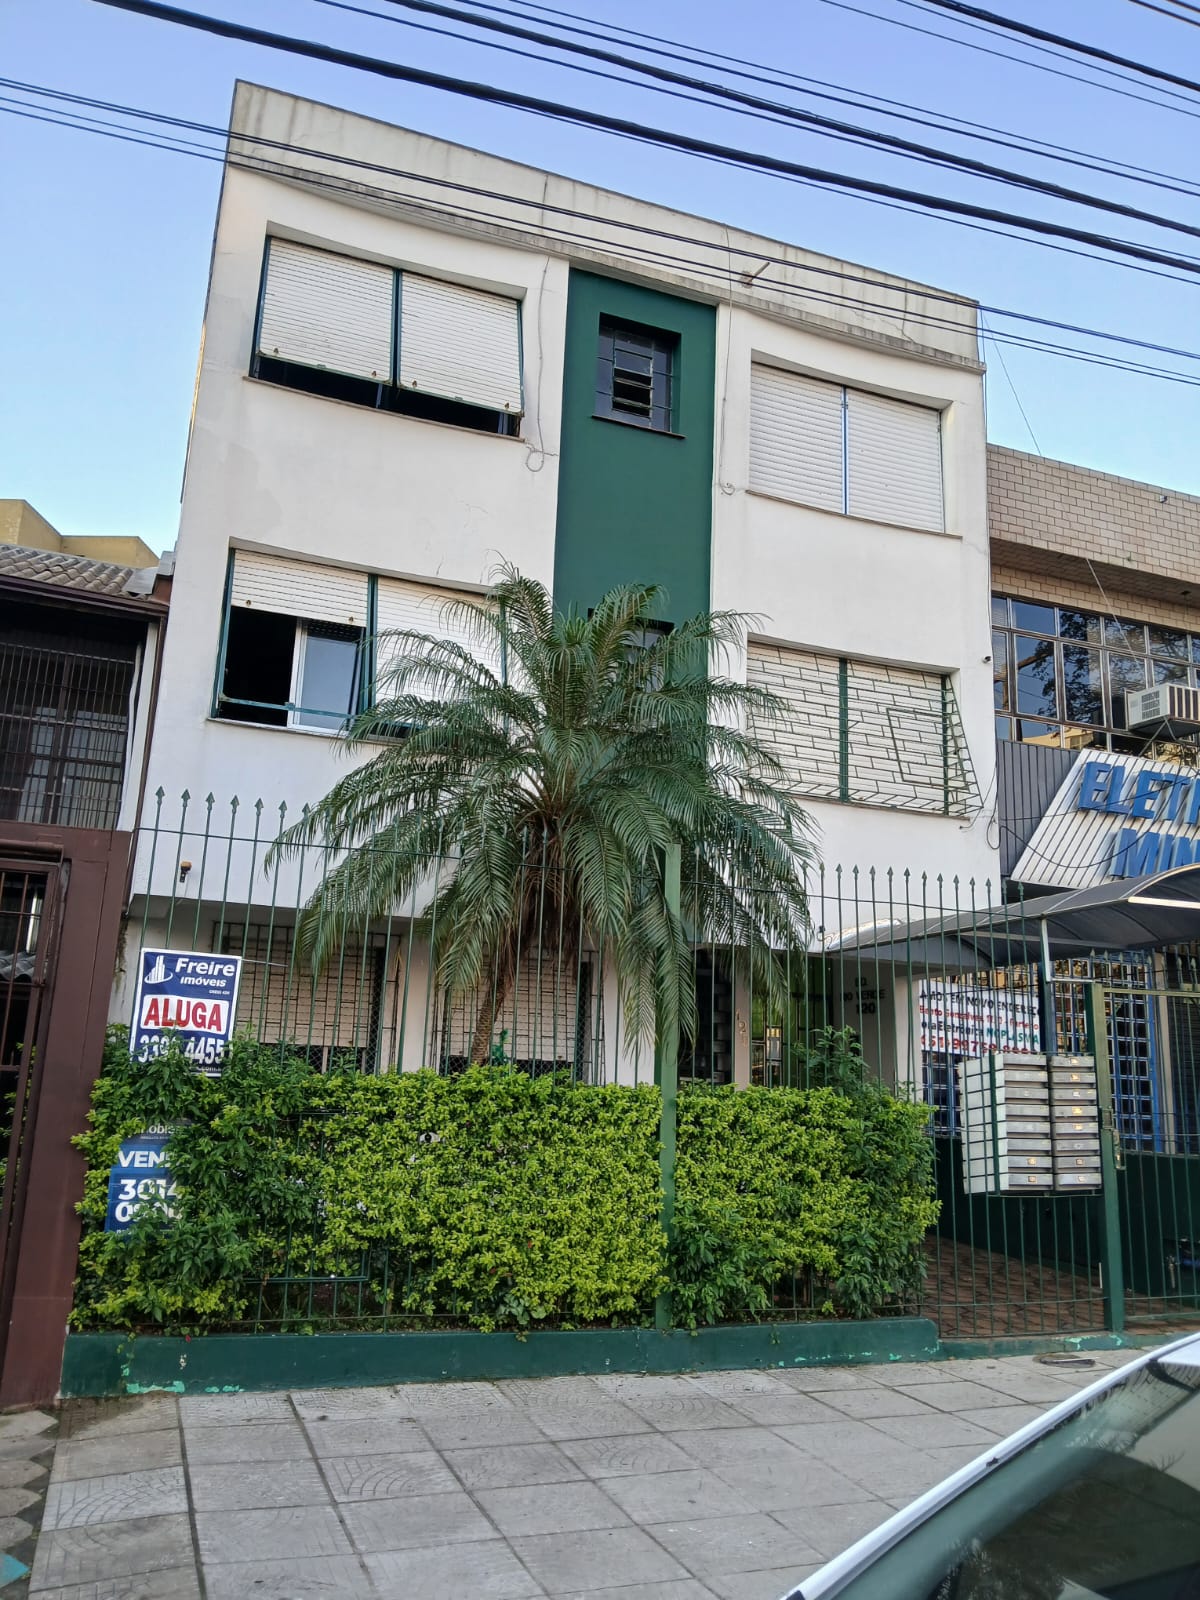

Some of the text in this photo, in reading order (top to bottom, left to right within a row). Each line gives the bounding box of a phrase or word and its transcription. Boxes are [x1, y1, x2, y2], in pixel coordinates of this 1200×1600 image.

[175, 957, 236, 977] Freire
[180, 976, 227, 987] imóveis
[143, 997, 222, 1032] ALUGA
